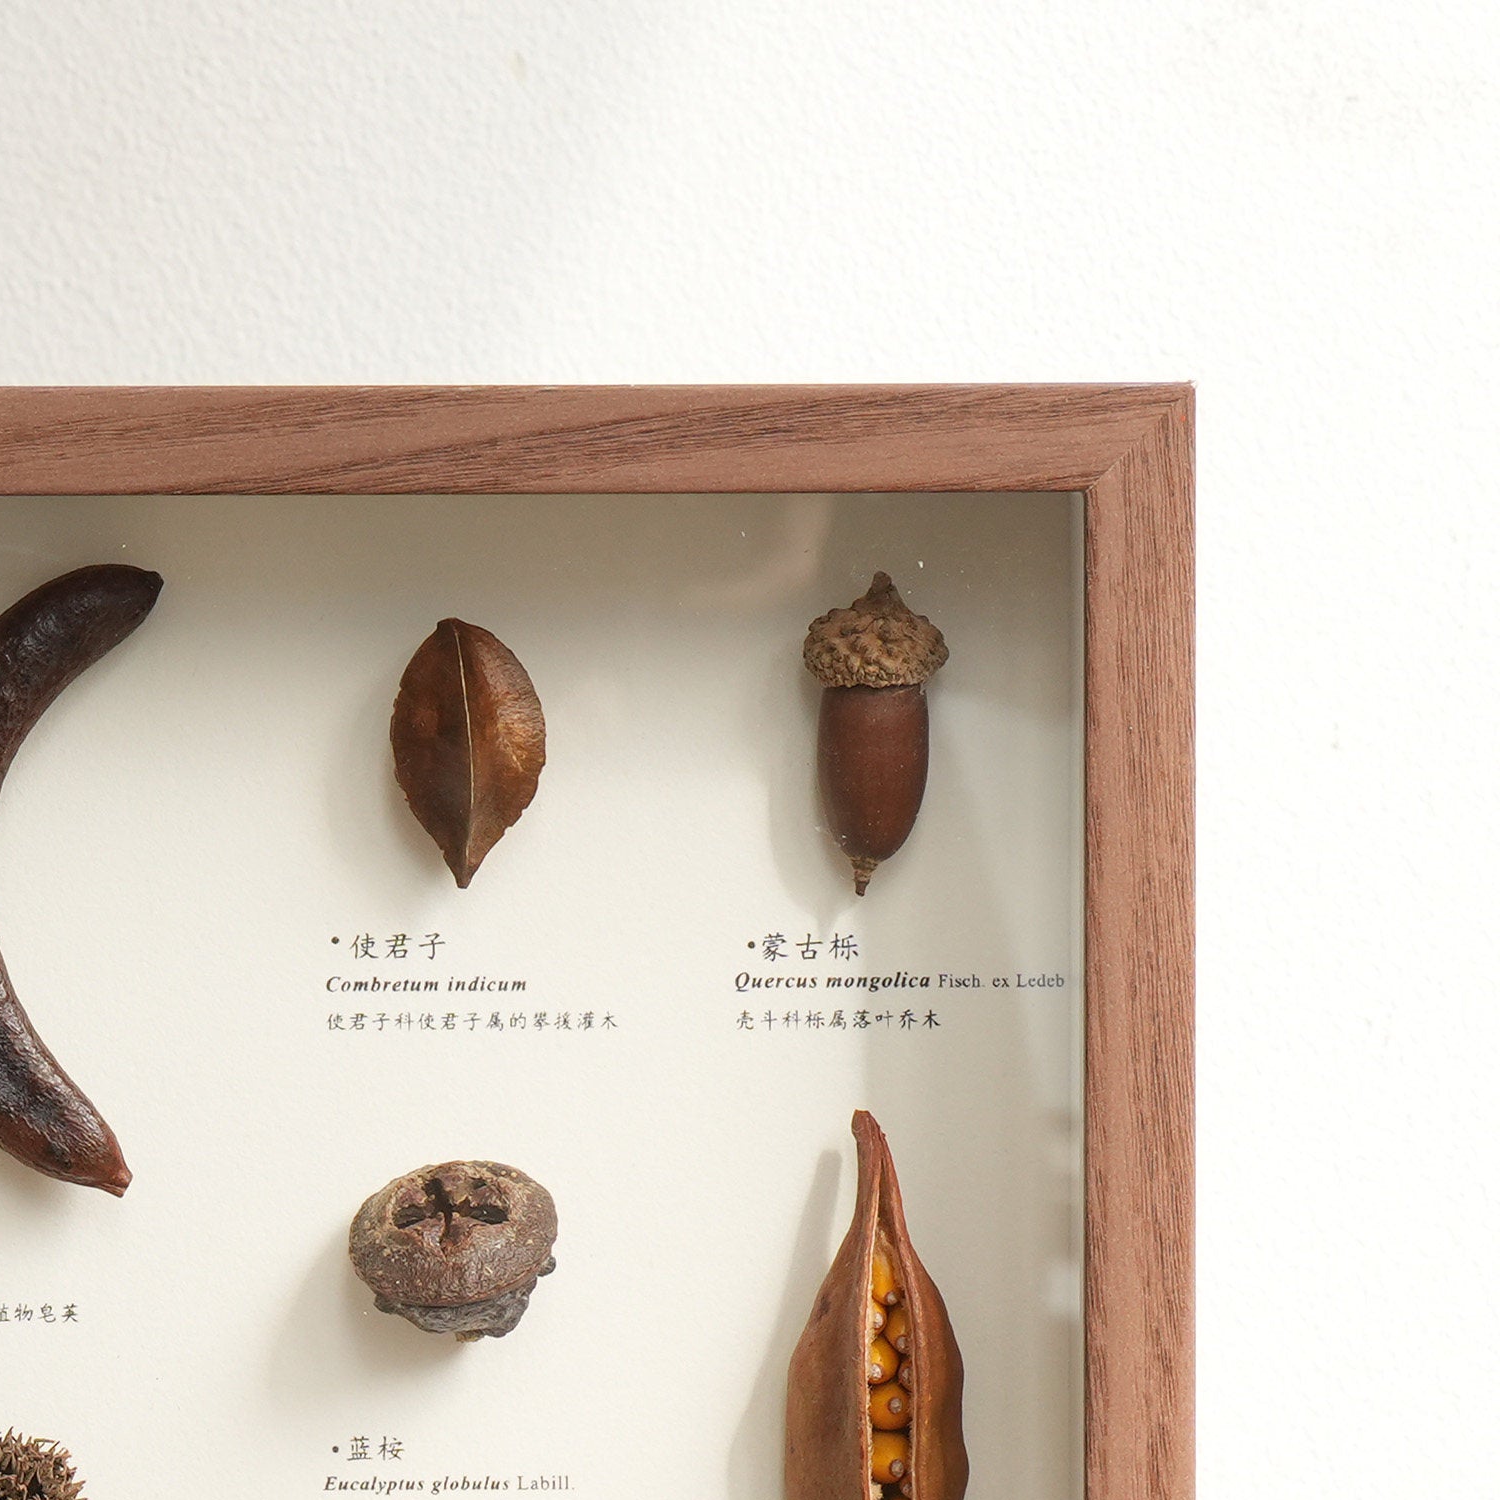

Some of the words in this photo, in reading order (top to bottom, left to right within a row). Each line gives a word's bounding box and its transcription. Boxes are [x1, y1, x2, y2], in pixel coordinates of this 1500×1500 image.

[349, 932, 447, 961] 使君子
[761, 932, 861, 962] 蒙古栎
[325, 975, 439, 993] Combretum
[447, 975, 528, 993] indicum
[734, 971, 818, 990] Quercus
[825, 971, 931, 993] mongolica
[992, 976, 1010, 988] ex
[735, 1008, 942, 1031] 壳斗科栎属落叶乔木
[346, 1435, 406, 1462] 蓝桉
[322, 1475, 426, 1496] Eucalyptus
[430, 1475, 511, 1496] globulus
[517, 1475, 576, 1491] Labill.
